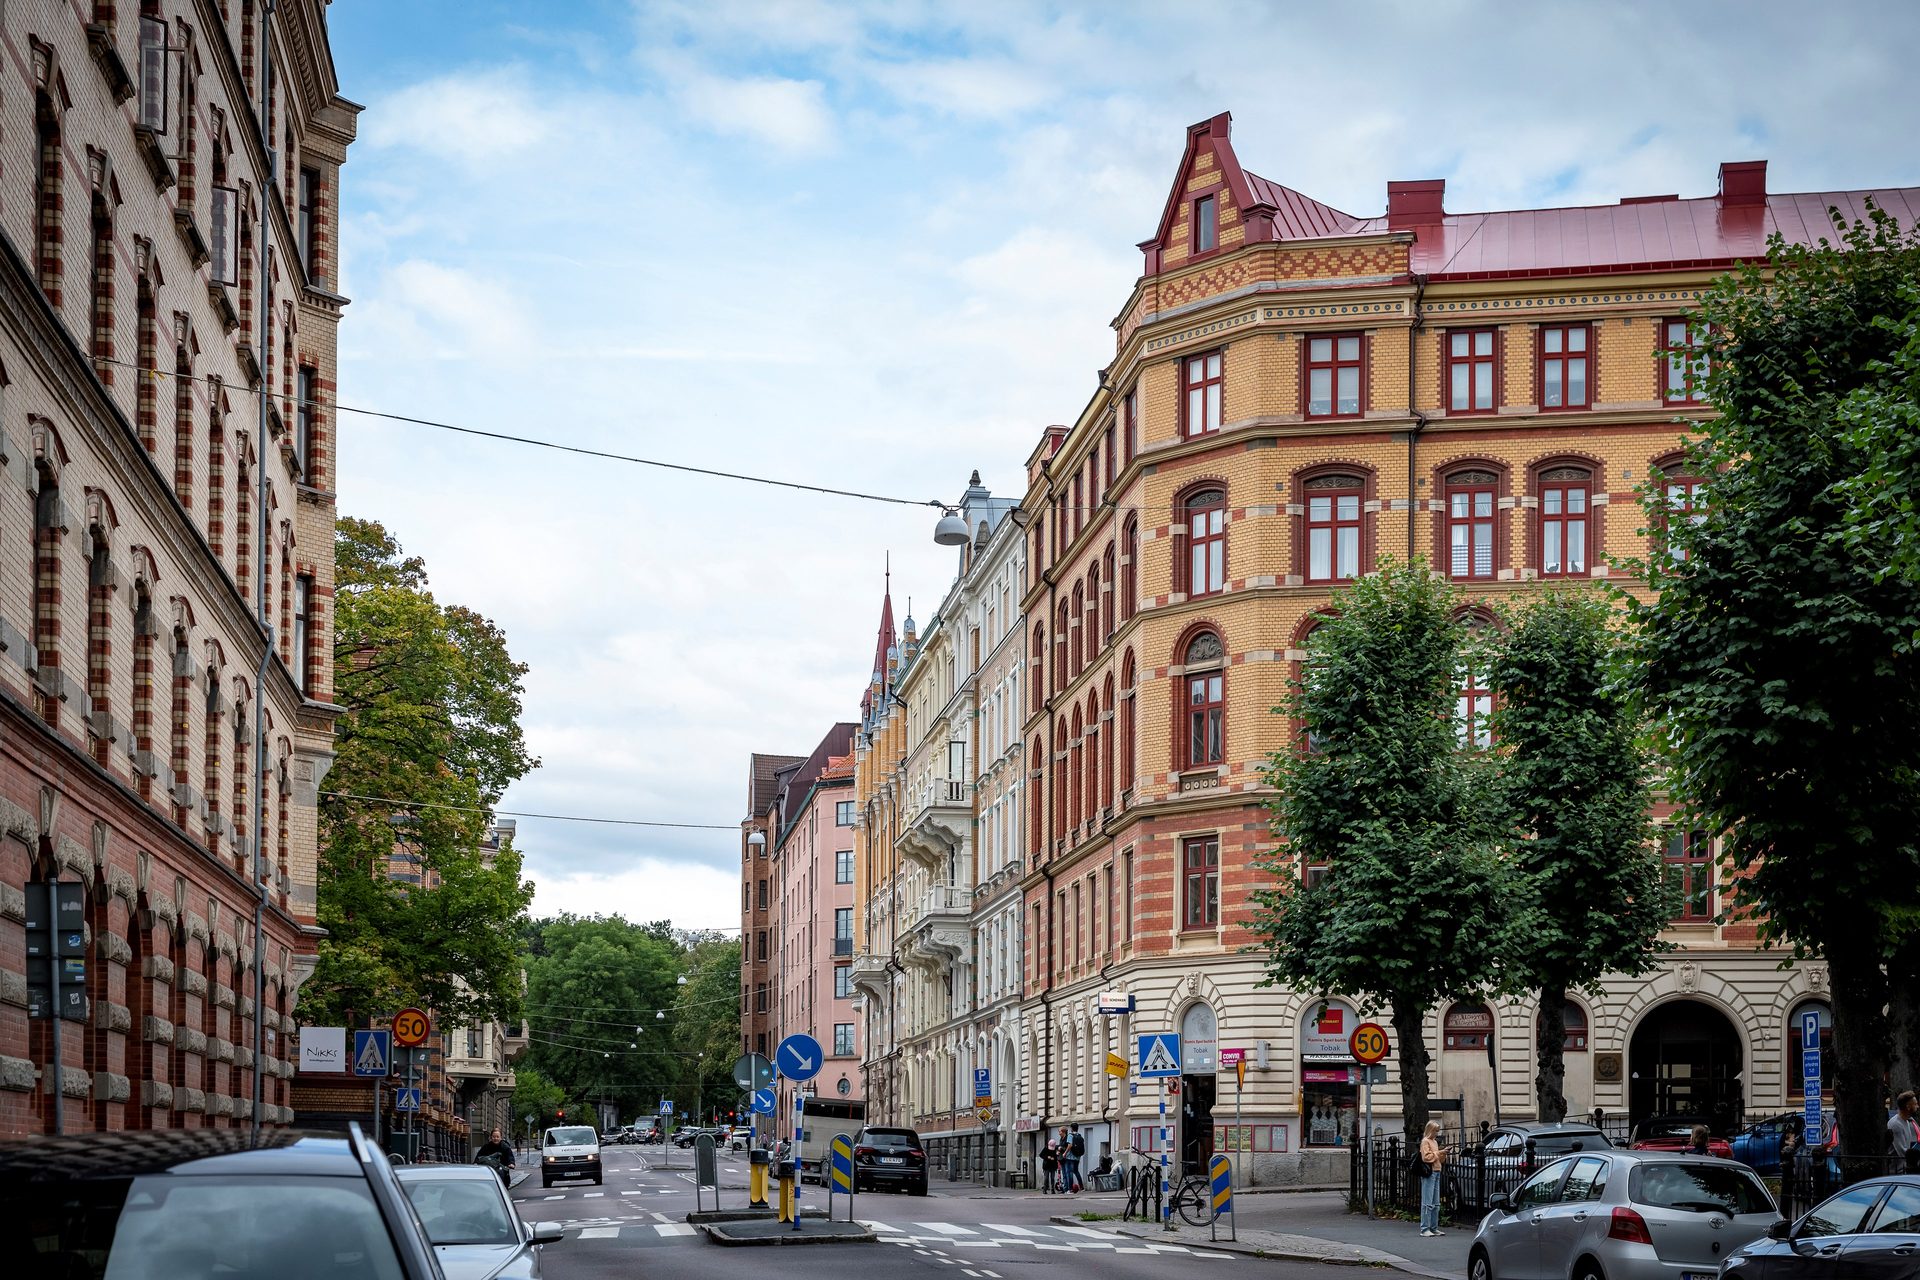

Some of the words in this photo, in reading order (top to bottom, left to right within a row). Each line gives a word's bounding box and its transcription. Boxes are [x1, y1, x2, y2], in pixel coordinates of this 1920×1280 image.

[398, 1018, 425, 1037] 50
[1806, 1016, 1816, 1046] P
[1357, 1033, 1383, 1054] 50
[1109, 1061, 1124, 1069] DHL
[978, 1070, 986, 1081] P
